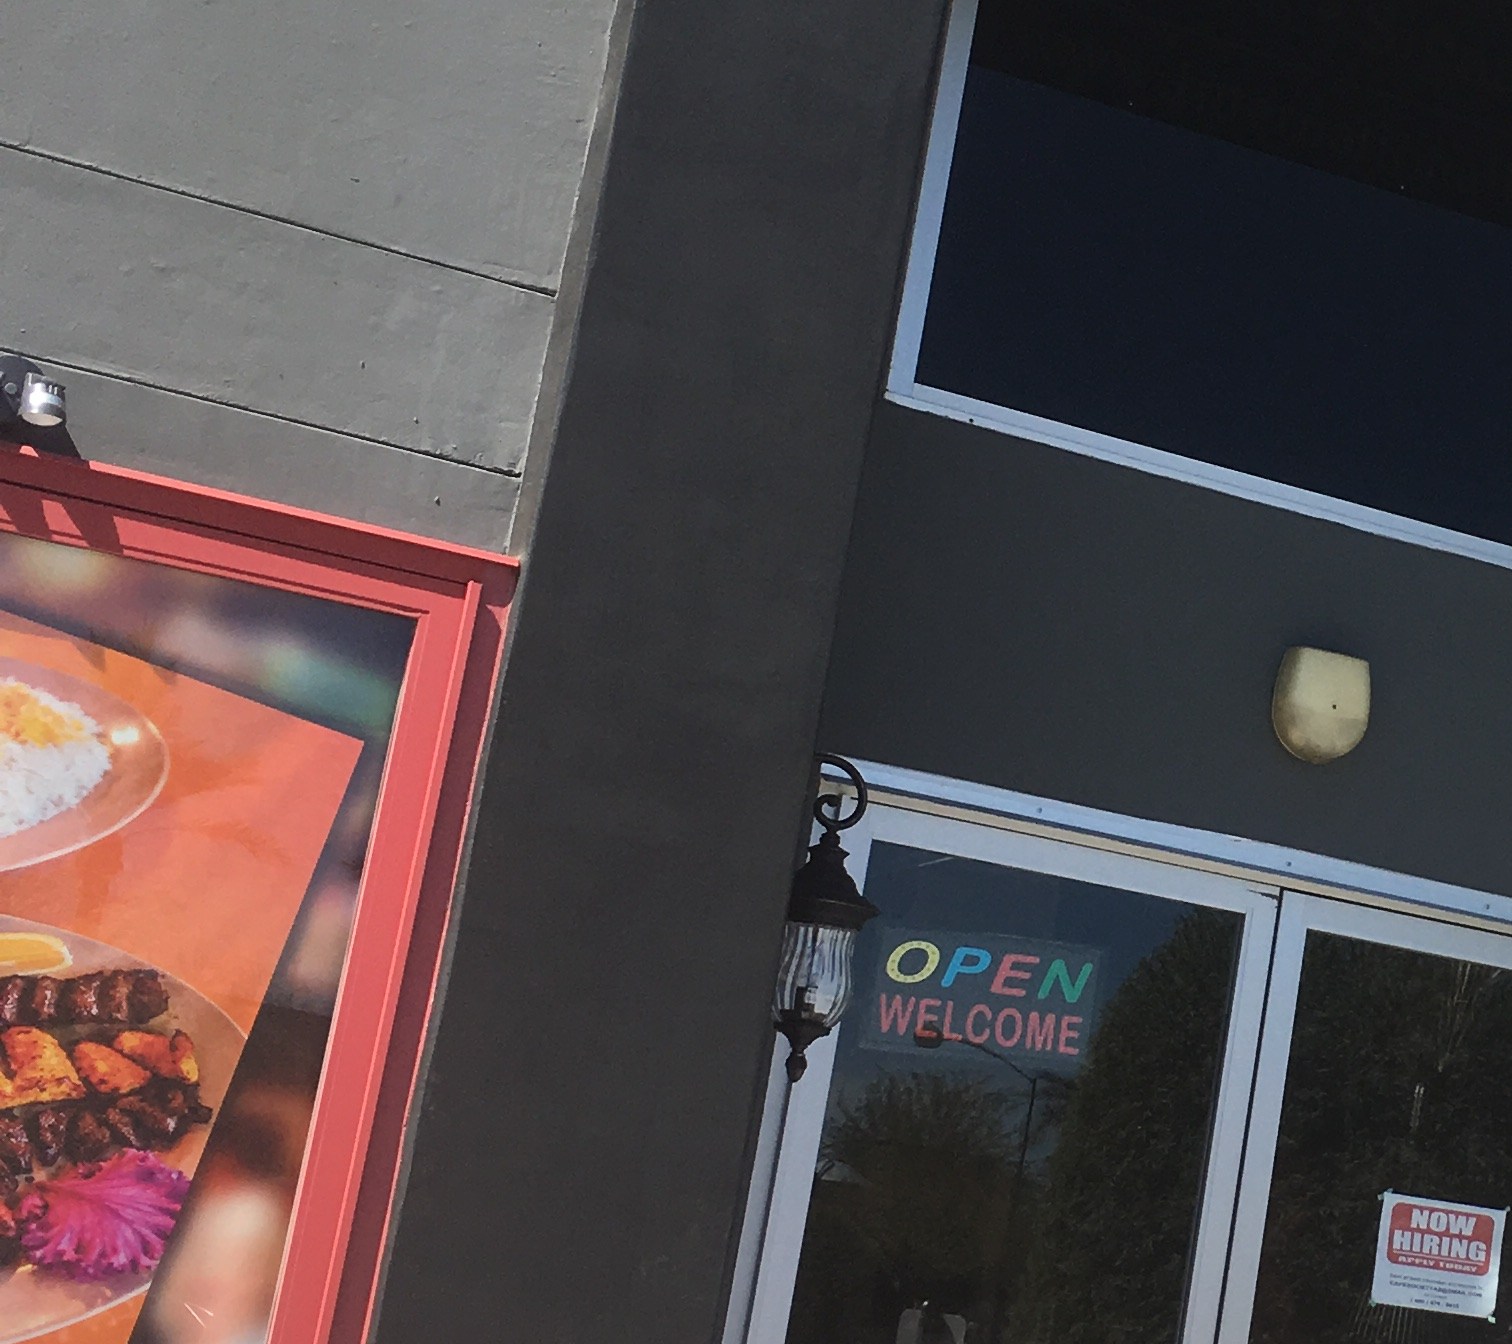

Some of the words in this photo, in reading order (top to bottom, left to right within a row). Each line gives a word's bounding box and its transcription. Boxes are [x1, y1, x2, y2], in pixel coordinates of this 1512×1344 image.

[886, 940, 1093, 1003] OPEN
[879, 993, 1084, 1055] WELCOME
[1392, 1229, 1487, 1262] HIRING
[1410, 1208, 1477, 1236] NOW
